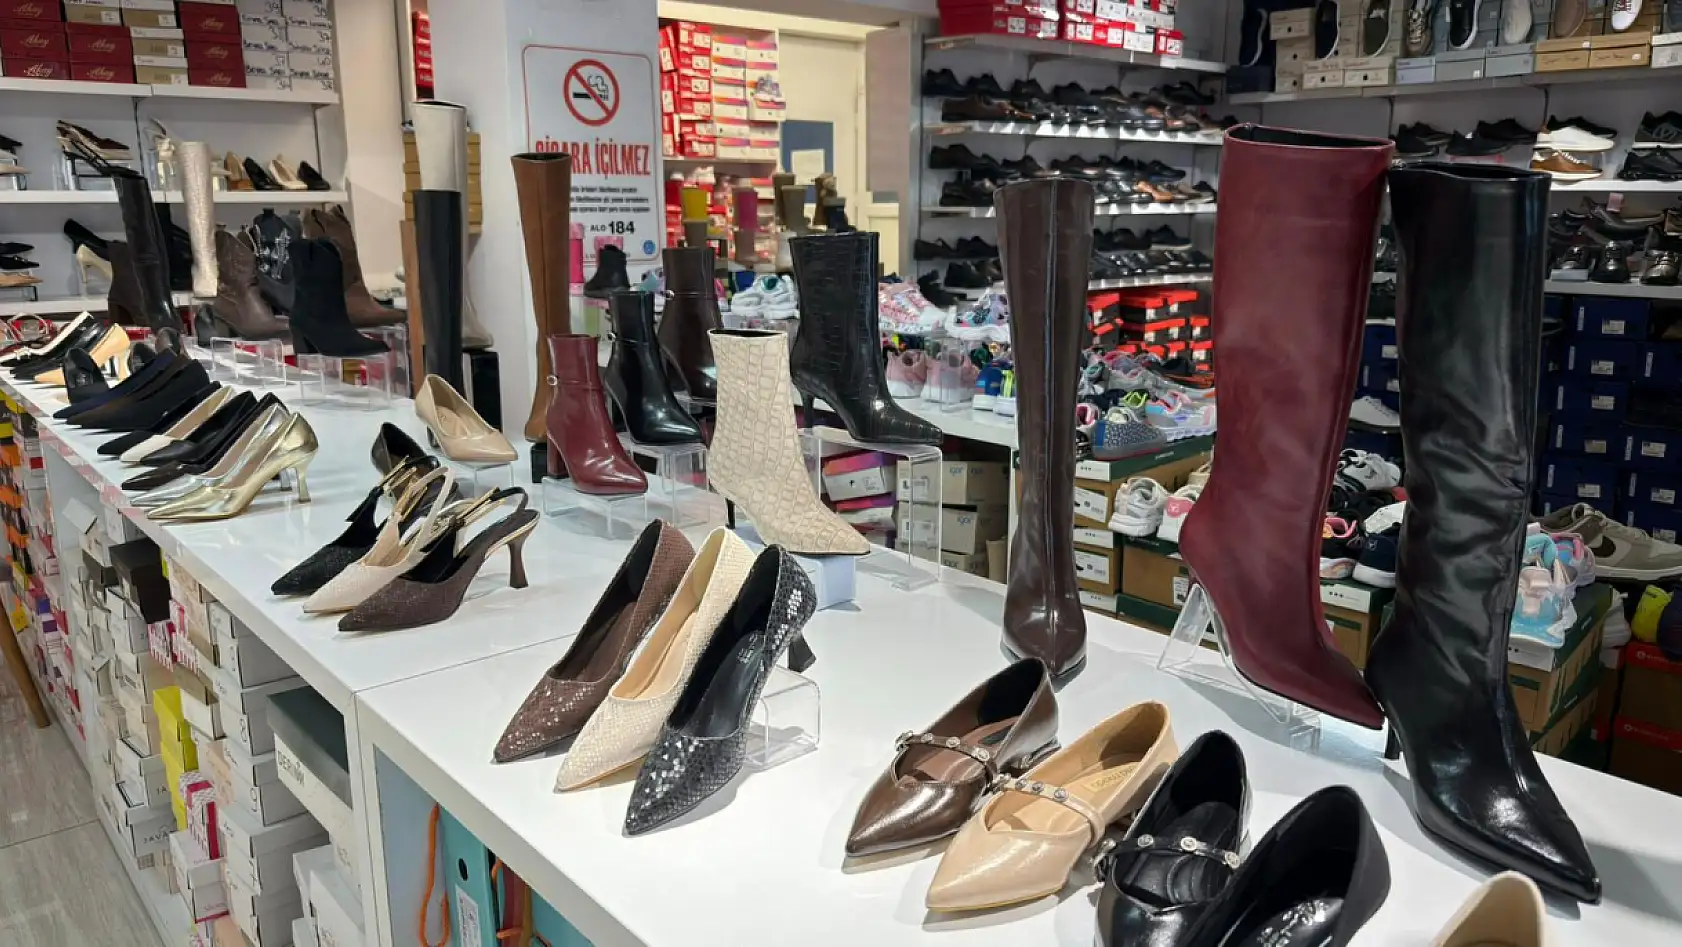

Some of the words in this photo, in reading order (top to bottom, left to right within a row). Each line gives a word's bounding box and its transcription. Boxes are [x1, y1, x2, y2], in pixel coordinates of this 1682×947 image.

[595, 137, 651, 180] İÇİLMEZ
[590, 223, 607, 232] ALO
[608, 220, 635, 234] 184
